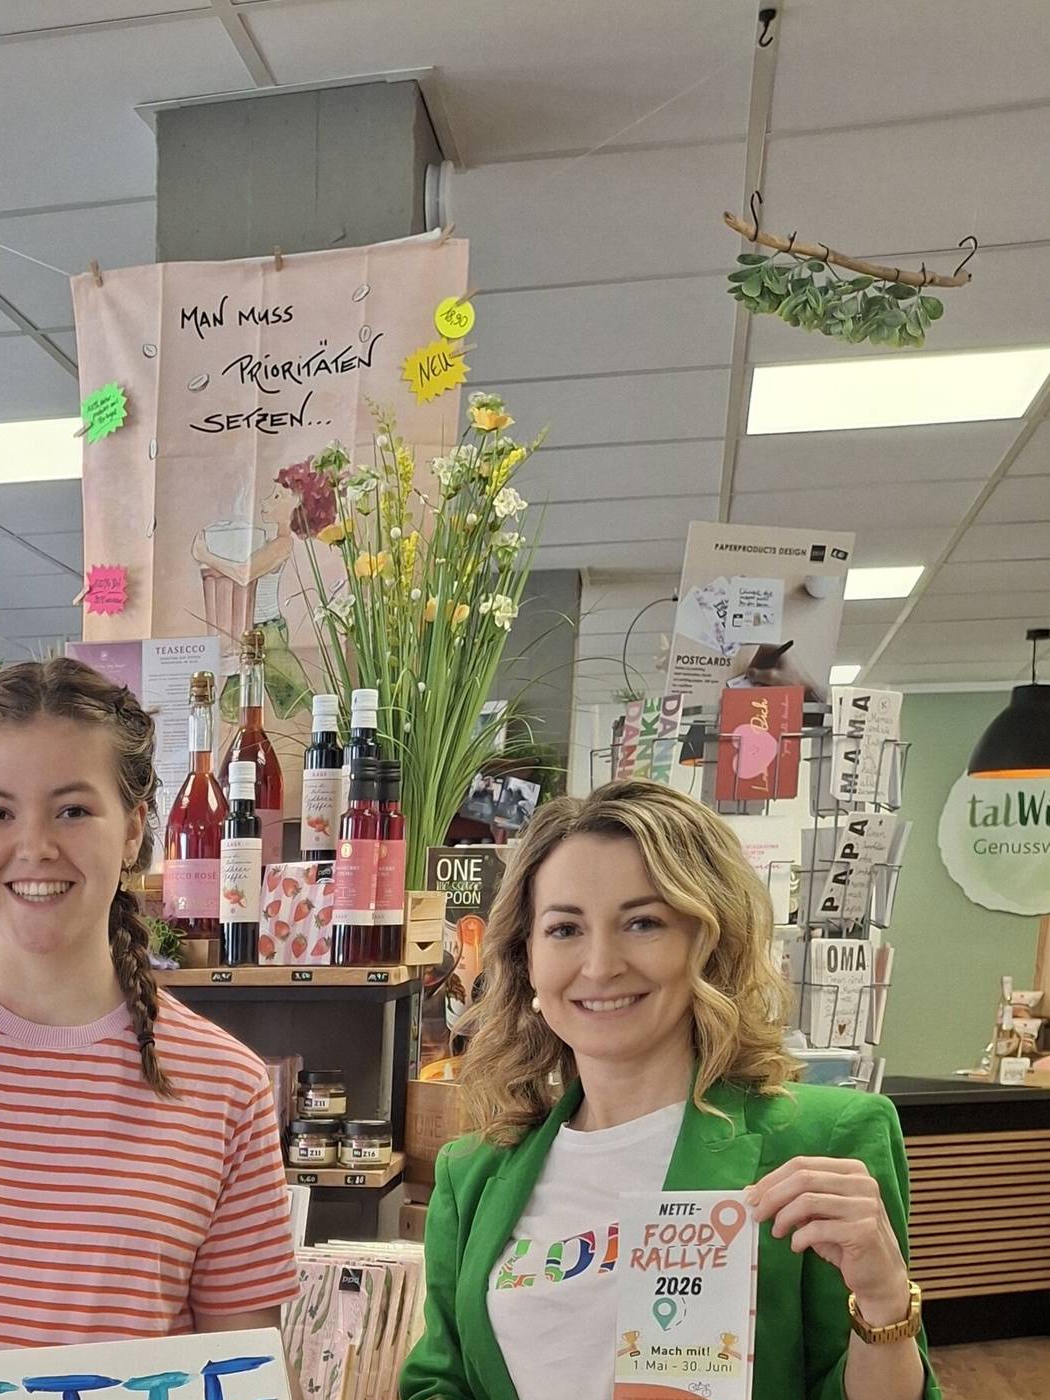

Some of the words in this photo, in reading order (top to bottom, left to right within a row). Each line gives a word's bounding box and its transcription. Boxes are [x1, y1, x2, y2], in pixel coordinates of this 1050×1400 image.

[181, 296, 229, 339] MAN
[238, 305, 294, 326] MUSS
[222, 333, 384, 394] PRIORITÄTEN
[418, 351, 455, 389] NEU
[714, 543, 777, 555] PAPERPRODUCTS
[778, 547, 807, 556] DESIGN
[155, 644, 206, 656] TEASECCO
[675, 655, 732, 668] POSTCARDS
[840, 695, 871, 795] MAMA
[436, 858, 482, 881] ONE
[446, 890, 481, 905] POON
[826, 944, 866, 973] OMA
[659, 1203, 702, 1217] NETTE-
[643, 1223, 715, 1246] FOOD
[630, 1245, 728, 1271] RALLYE
[655, 1277, 703, 1297] 2026
[651, 1346, 682, 1357] Mach
[687, 1346, 710, 1357] mit!
[646, 1360, 667, 1371] Mai
[705, 1360, 732, 1374] Juni
